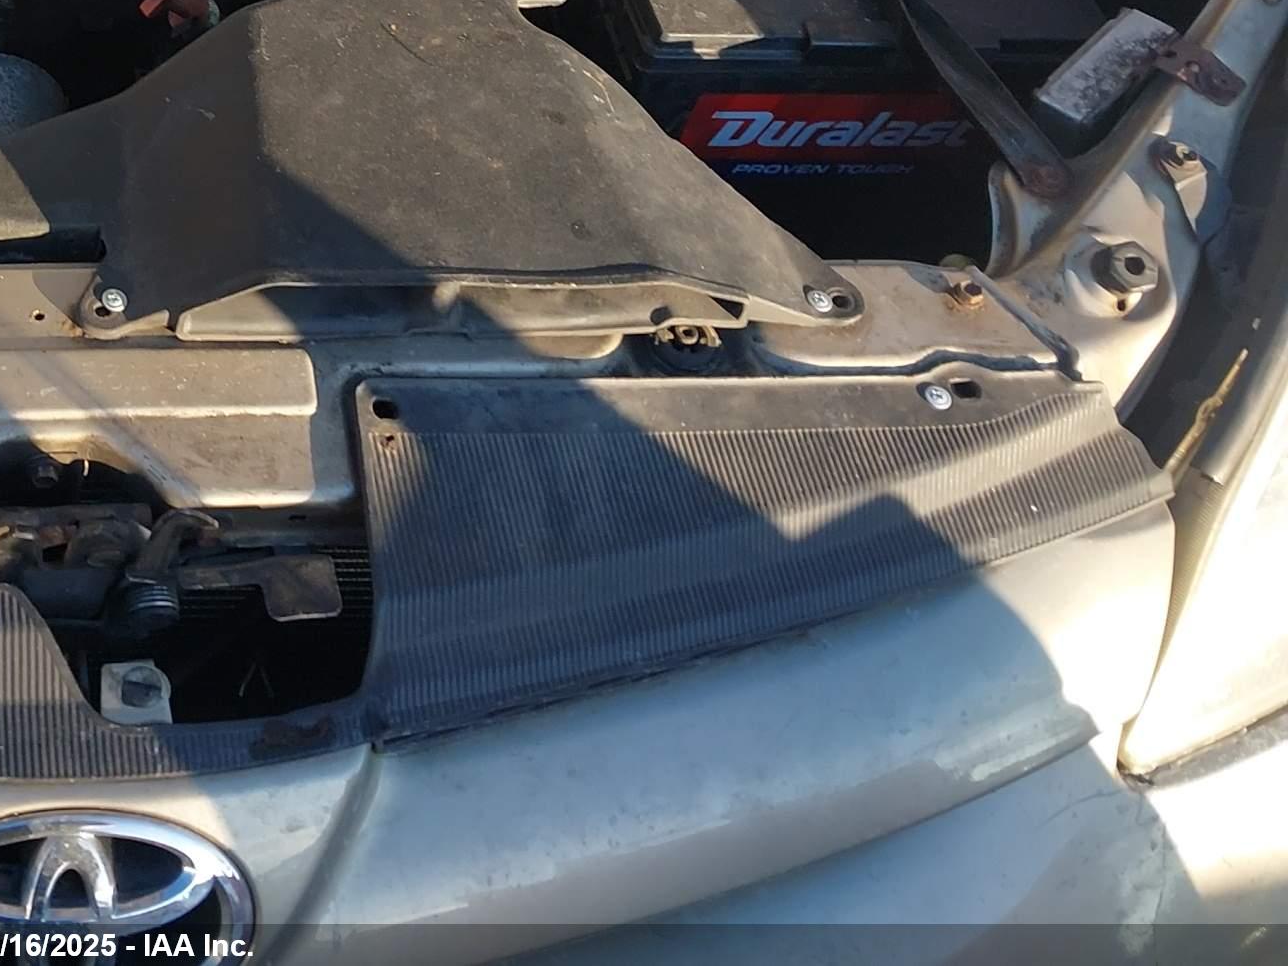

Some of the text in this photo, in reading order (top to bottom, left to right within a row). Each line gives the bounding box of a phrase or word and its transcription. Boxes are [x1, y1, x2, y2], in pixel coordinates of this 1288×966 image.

[706, 110, 972, 147] Duralast
[731, 163, 914, 175] PROVEN TOUGH
